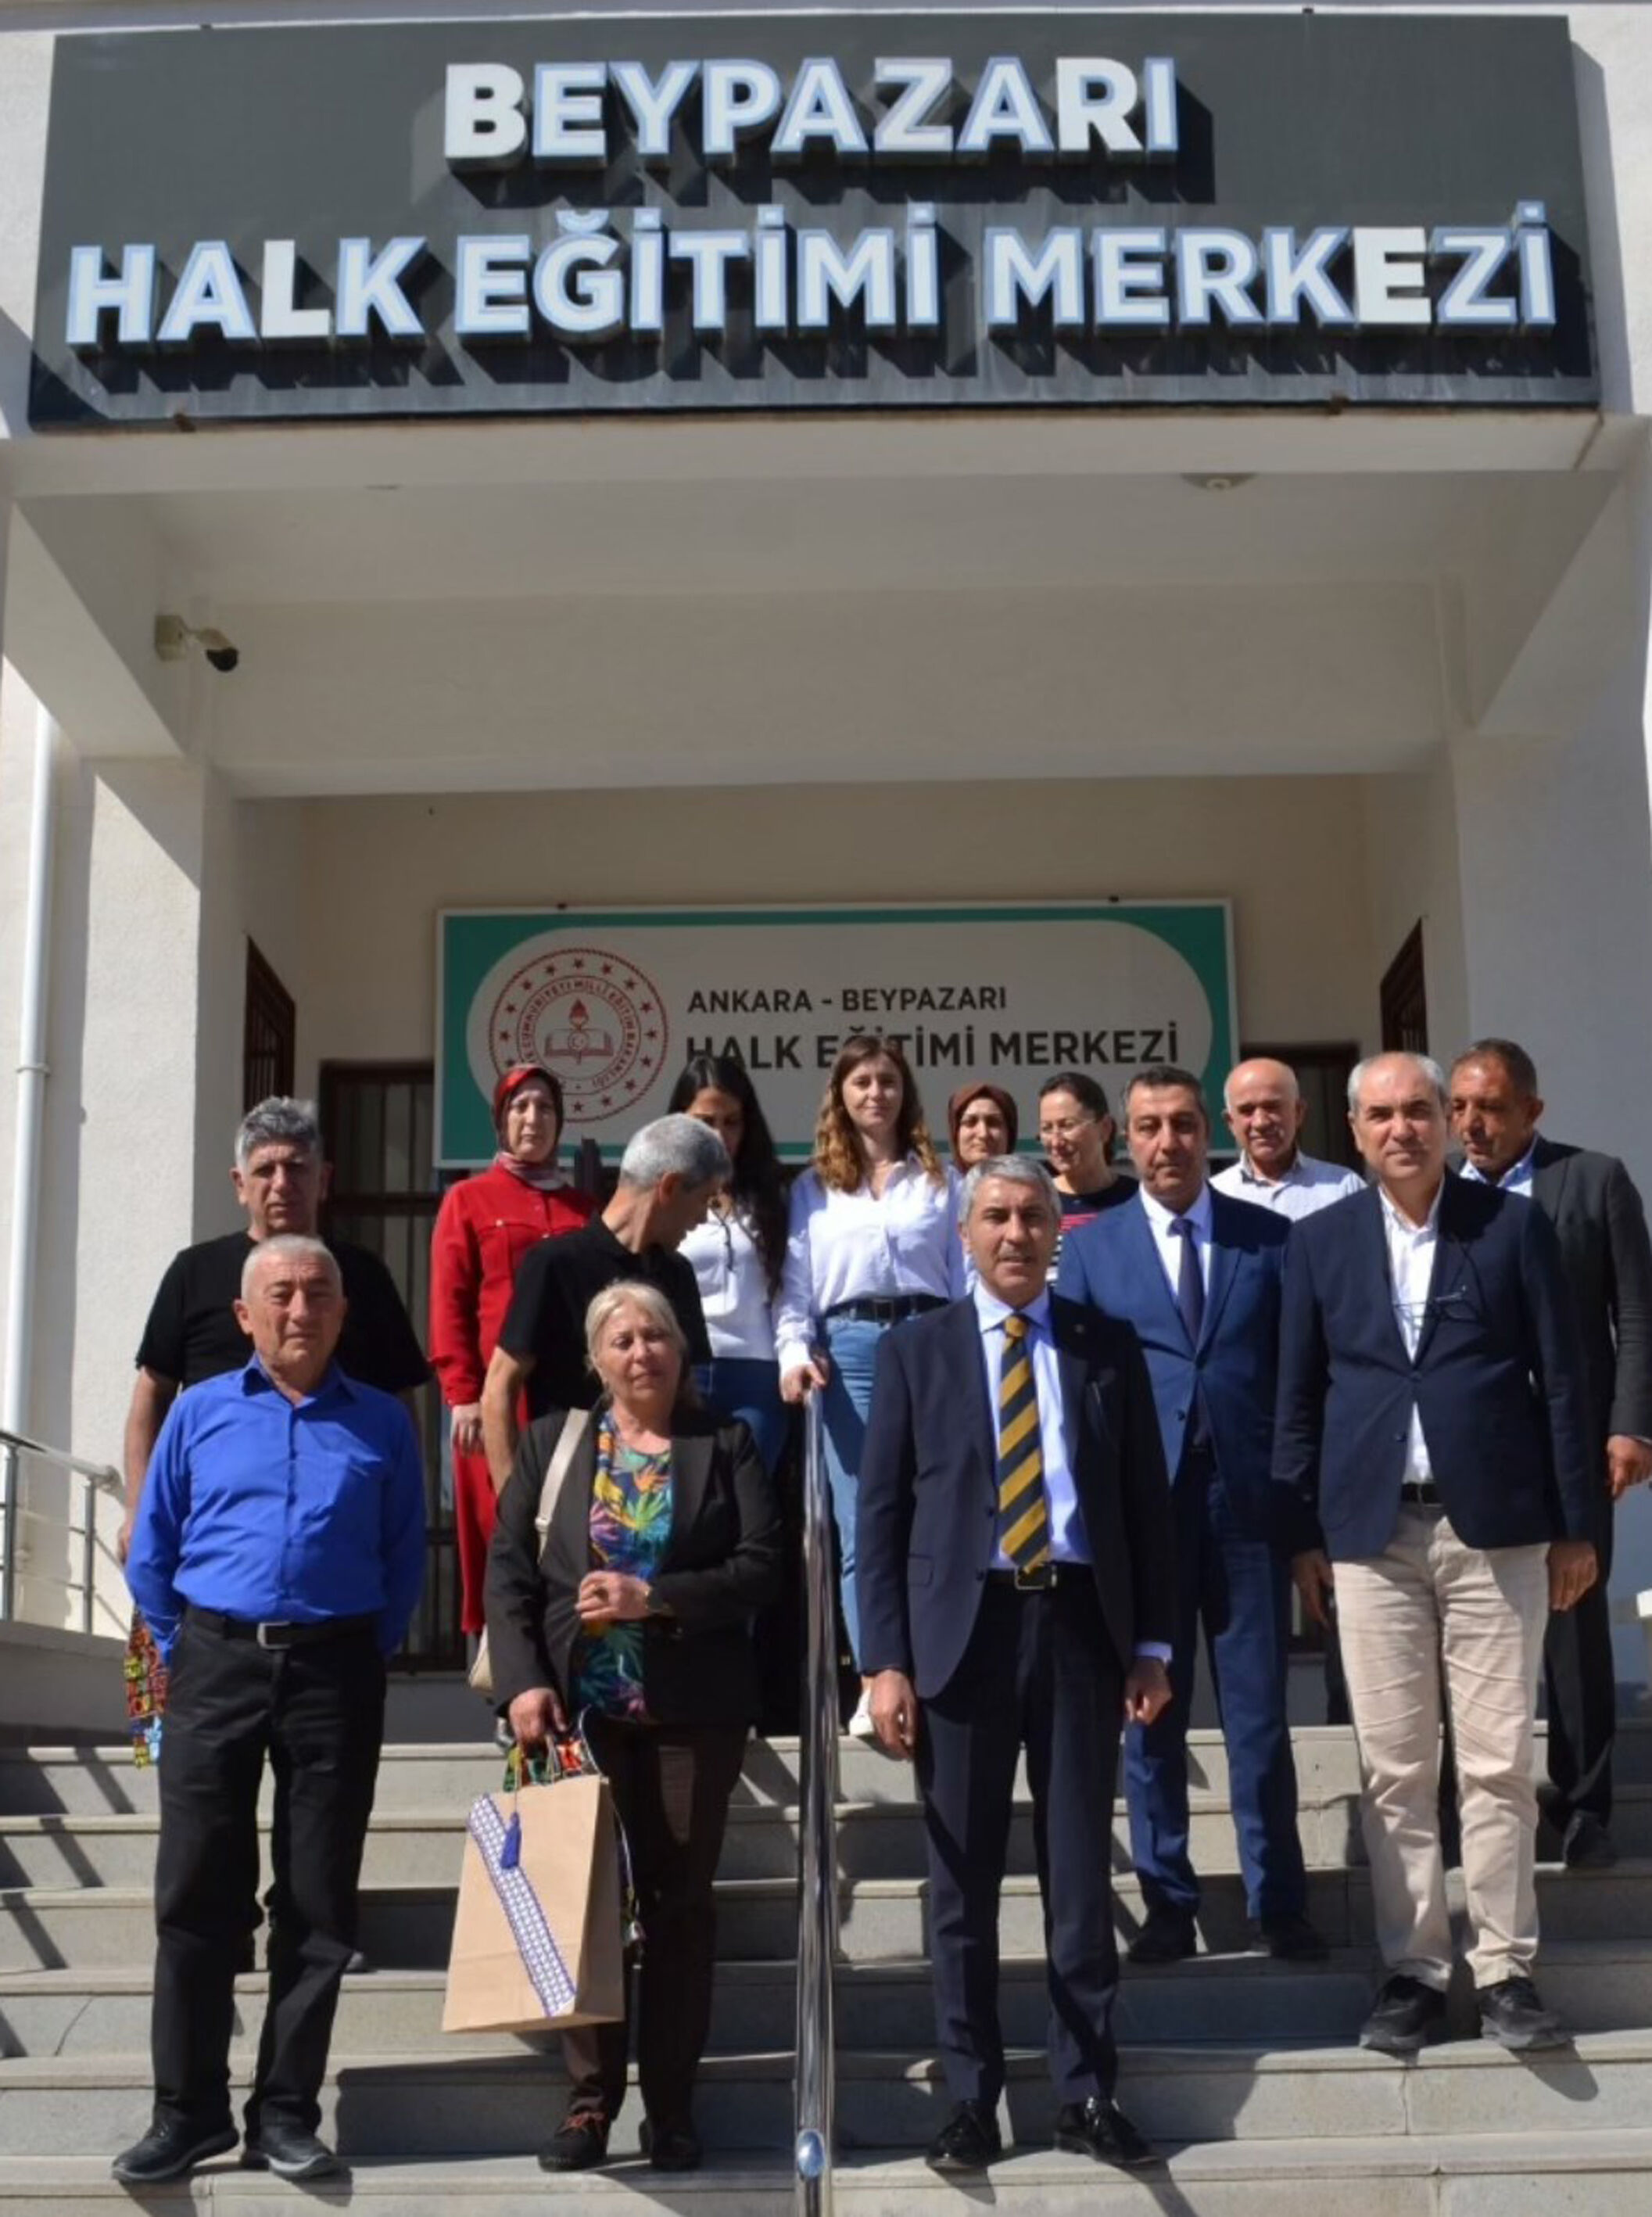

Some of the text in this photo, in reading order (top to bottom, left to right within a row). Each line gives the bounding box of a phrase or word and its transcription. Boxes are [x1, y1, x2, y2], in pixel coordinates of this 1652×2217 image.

[444, 57, 1179, 160] BEYPAZARI
[66, 200, 1556, 344] HALK EĞİTİMİ MERKEZİ
[688, 988, 812, 1013] ANKARA
[842, 986, 1006, 1011] BEYPAZARI
[686, 1035, 801, 1069] HALK
[990, 1021, 1178, 1066] MERKEZİ
